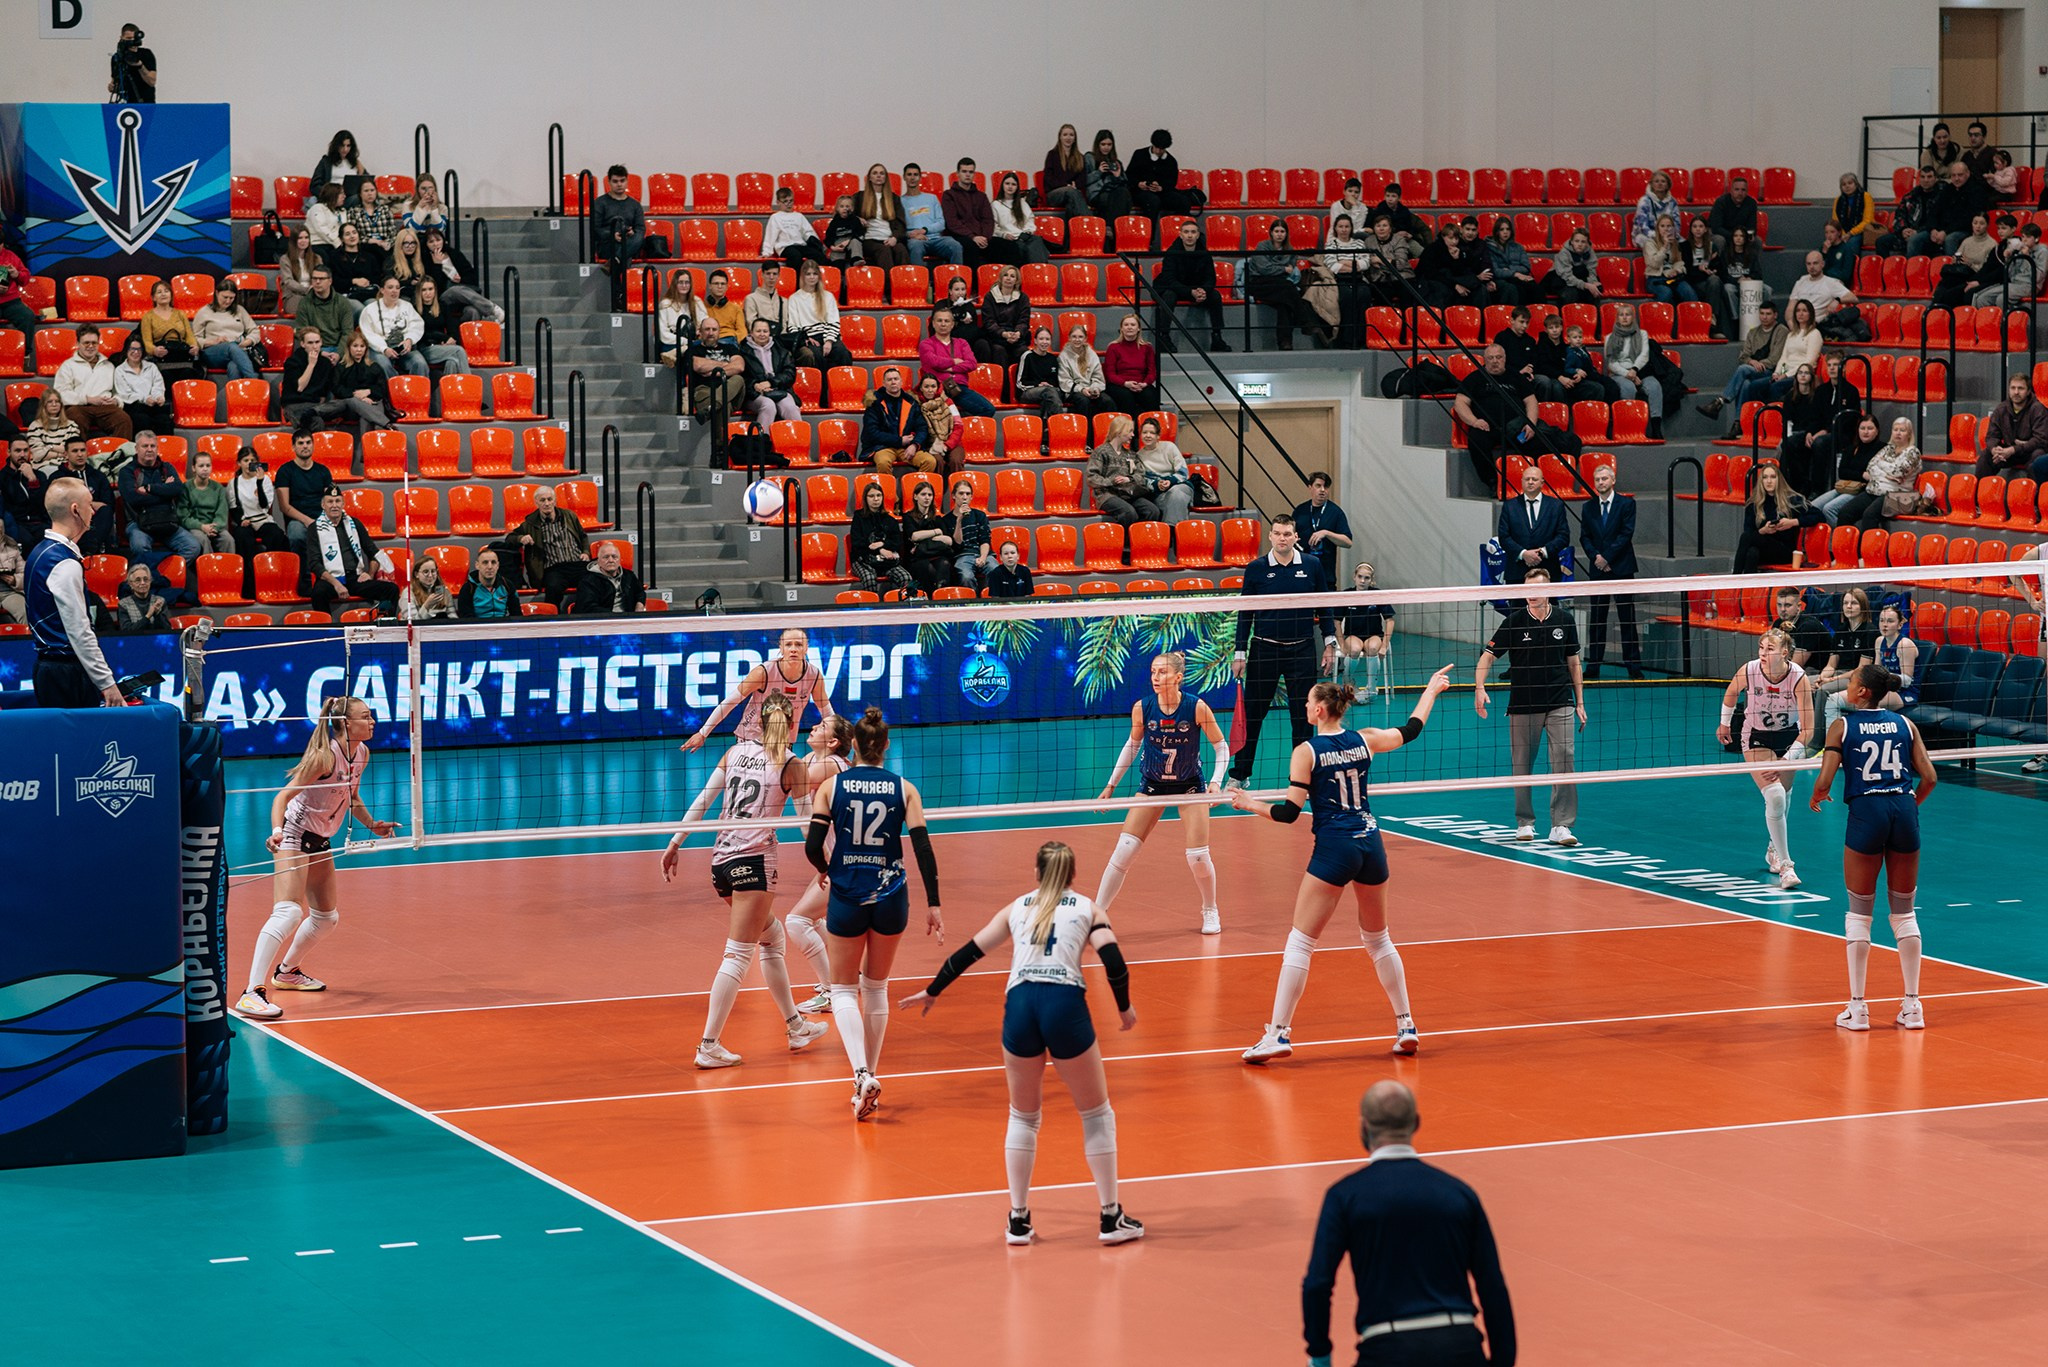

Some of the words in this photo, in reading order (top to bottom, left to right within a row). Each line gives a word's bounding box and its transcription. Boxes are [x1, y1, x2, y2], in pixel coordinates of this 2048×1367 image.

[52, 0, 83, 29] D
[552, 221, 558, 229] 9
[614, 317, 619, 325] 7
[682, 421, 688, 430] 5
[595, 476, 602, 485] 4
[714, 474, 720, 483] 4
[630, 534, 637, 543] 3
[752, 531, 759, 540] 3
[664, 593, 670, 602] 2
[789, 591, 795, 600] 2
[306, 643, 922, 726] САНКТ-ПЕТЕРУРГ
[1761, 711, 1789, 727] 23
[1859, 722, 1898, 735] МОРЕНО
[735, 754, 768, 771] ПОЗЮК
[1162, 749, 1177, 774] 7
[1861, 740, 1903, 781] 24
[0, 780, 40, 801] ФВ
[80, 778, 150, 796] КОРАБЕЛКА
[843, 780, 896, 795] ЧЕРНЯЕВА
[1335, 768, 1362, 811] 11
[728, 776, 761, 818] 12
[850, 800, 888, 846] 12
[843, 854, 887, 866] КОРАБЕЛКА
[181, 826, 224, 1023] КОРАБЕЛКА
[1030, 922, 1057, 956] 4
